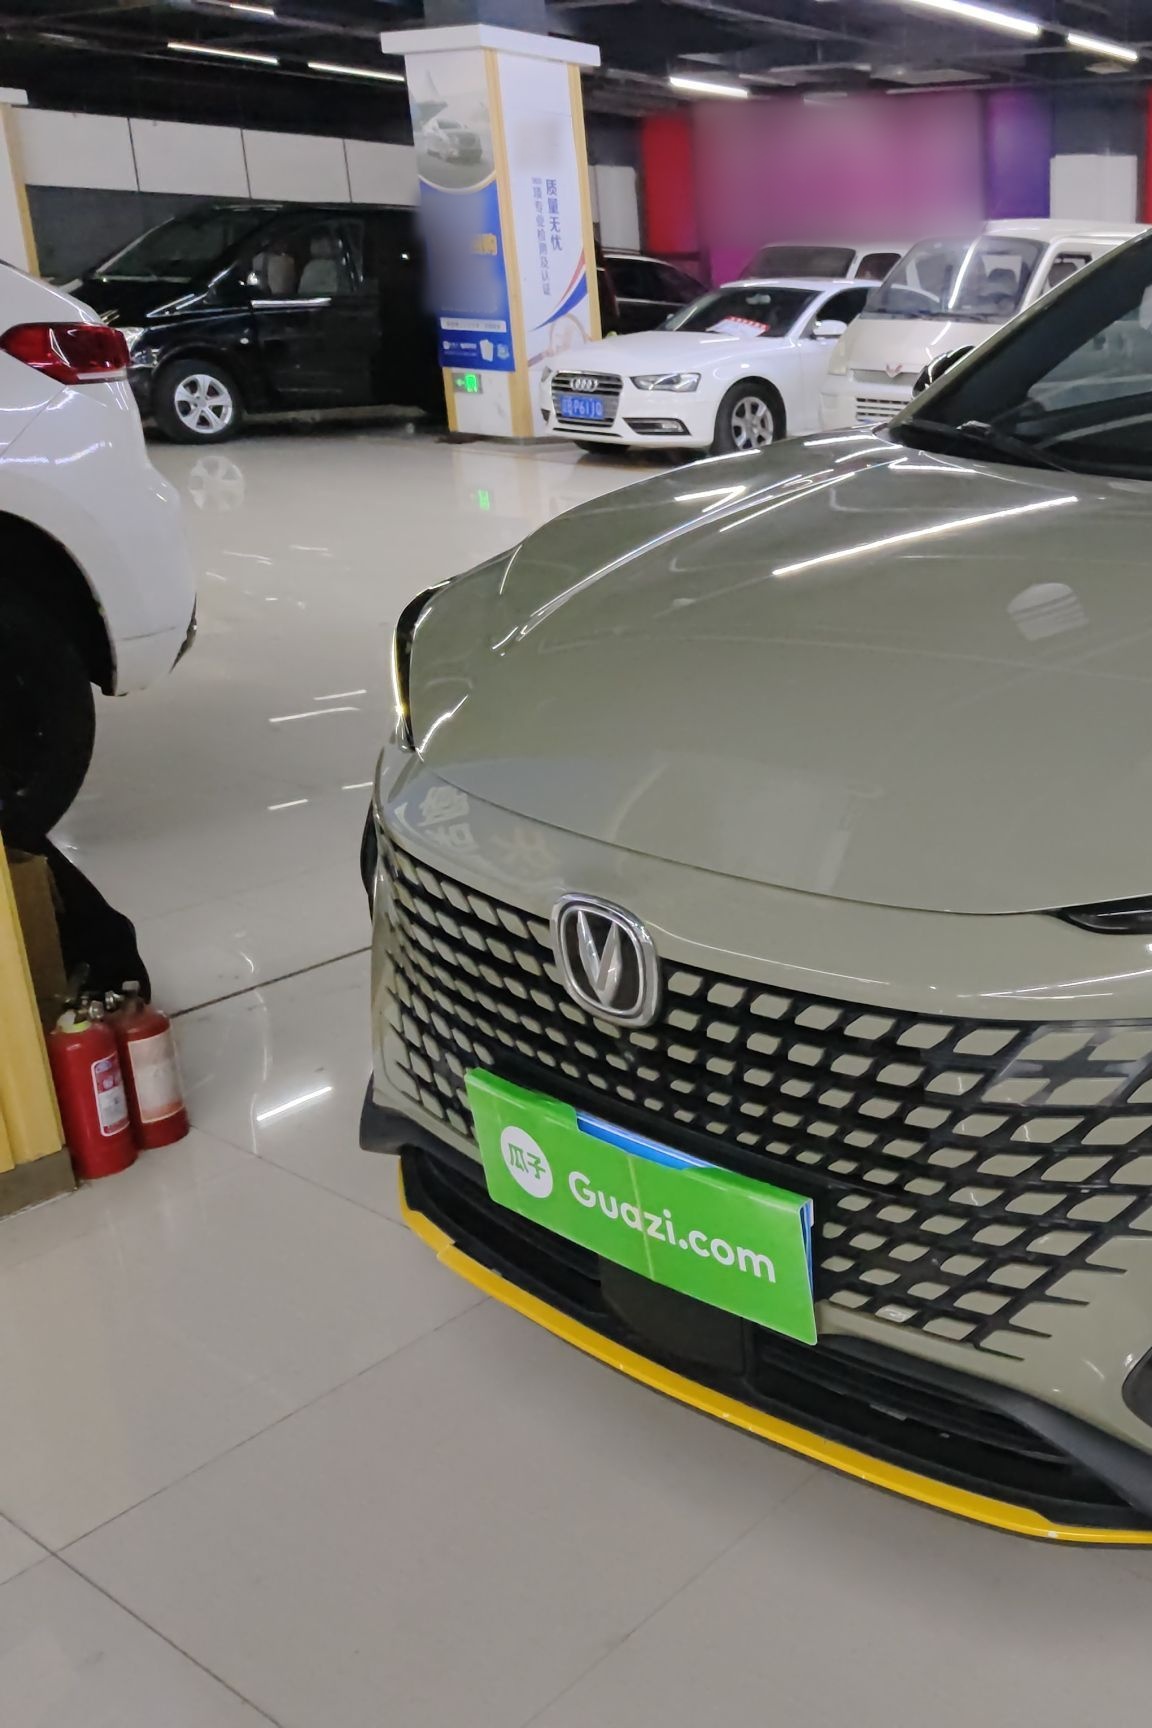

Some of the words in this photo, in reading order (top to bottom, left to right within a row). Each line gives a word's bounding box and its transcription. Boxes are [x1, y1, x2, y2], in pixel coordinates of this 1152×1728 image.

[545, 178, 563, 251] 质量无忧
[507, 1142, 547, 1180] 瓜子
[568, 1170, 777, 1284] Guazi.com
